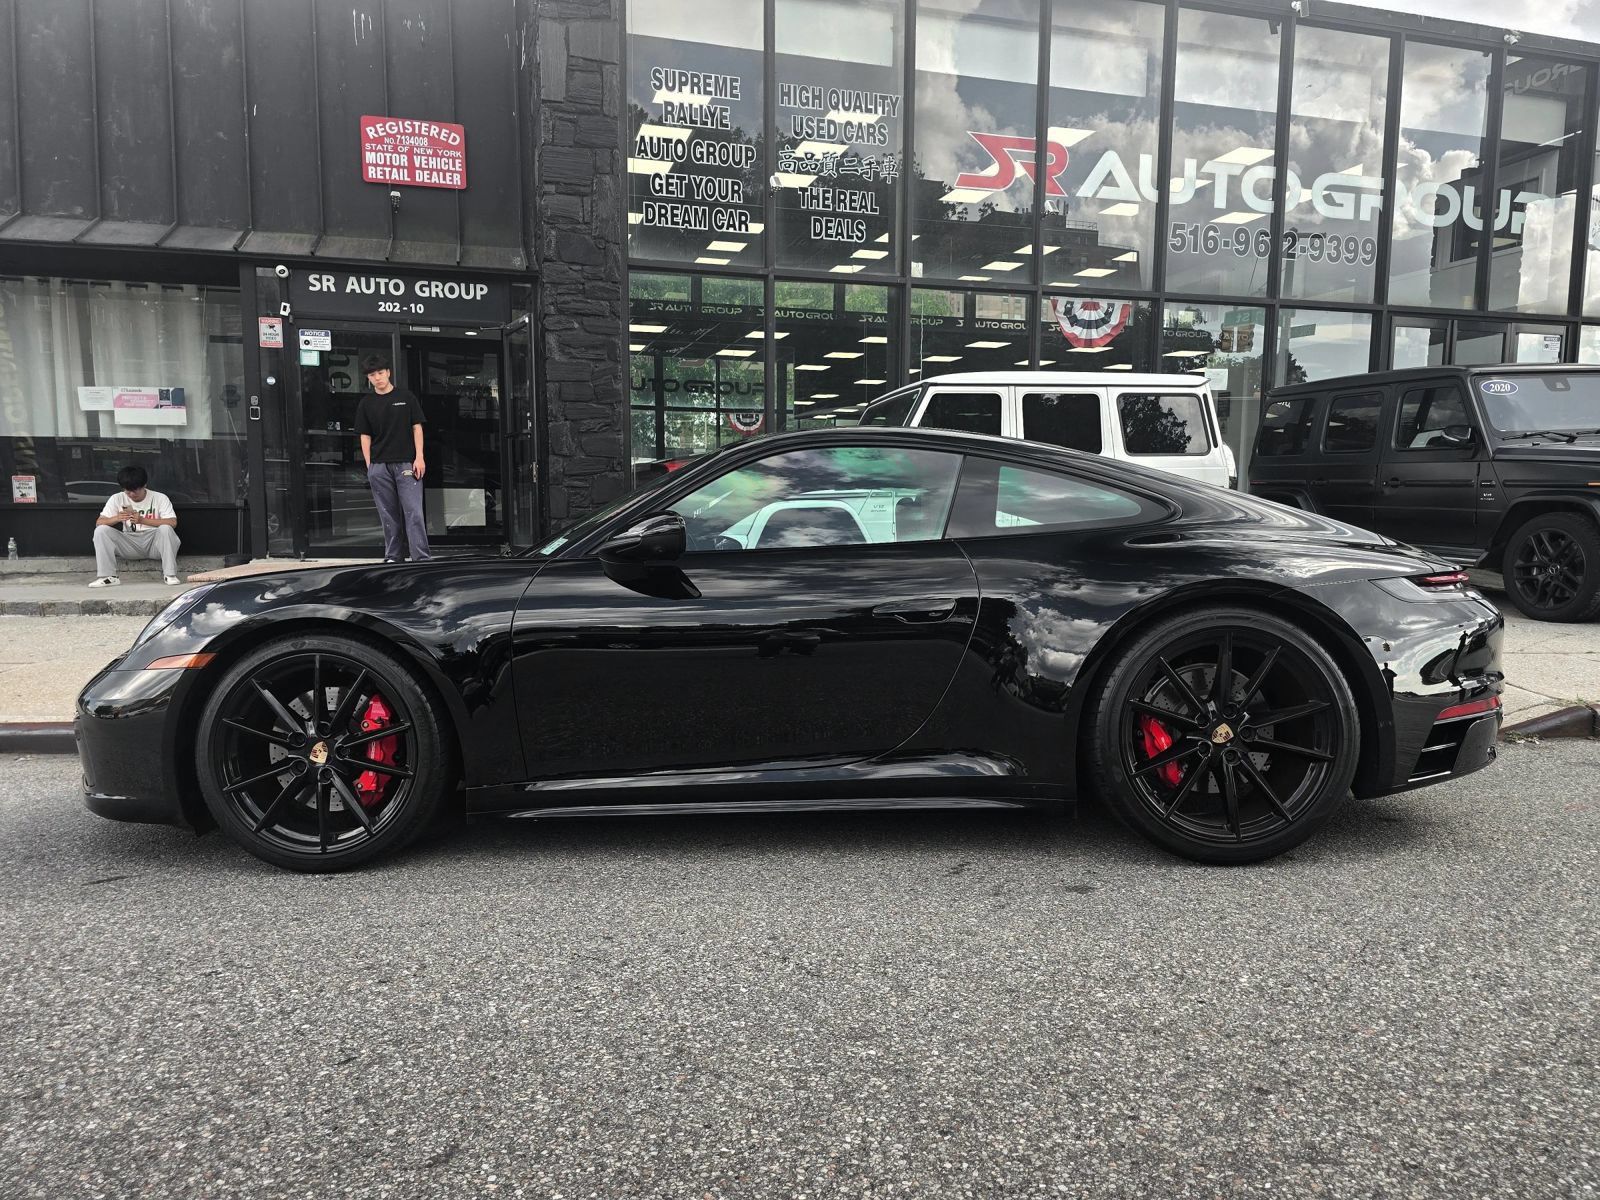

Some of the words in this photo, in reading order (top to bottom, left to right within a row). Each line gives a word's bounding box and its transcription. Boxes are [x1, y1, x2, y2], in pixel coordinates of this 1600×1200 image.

[651, 66, 741, 101] SUPREME
[778, 82, 824, 111] HIGH
[826, 87, 901, 118] QUALITY
[662, 100, 731, 130] RALLYE
[365, 120, 461, 146] REGISTERED
[791, 114, 839, 142] USED
[843, 119, 889, 147] CARS
[365, 143, 394, 152] STATE
[397, 146, 410, 154] OF
[413, 147, 433, 156] NEW
[437, 149, 462, 158] YORK
[365, 151, 408, 167] MOTOR
[413, 155, 463, 172] VEHICLE
[635, 134, 686, 163] AUTO
[691, 139, 757, 169] GROUP
[777, 145, 901, 185] 高品質二手車
[368, 166, 411, 182] RETAIL
[415, 170, 461, 186] DEALER
[954, 131, 1069, 197] SR
[1075, 150, 1301, 213] AUTO
[650, 172, 688, 199] GET
[689, 175, 743, 204] YOUR
[798, 186, 833, 210] THE
[836, 189, 880, 215] REAL
[643, 201, 709, 231] DREAM
[712, 207, 750, 233] CAR
[811, 216, 866, 243] DEALS
[308, 273, 336, 292] SR
[345, 276, 405, 296] AUTO
[414, 280, 489, 300] GROUP
[304, 330, 326, 338] NOTICE
[1489, 383, 1511, 393] 2020
